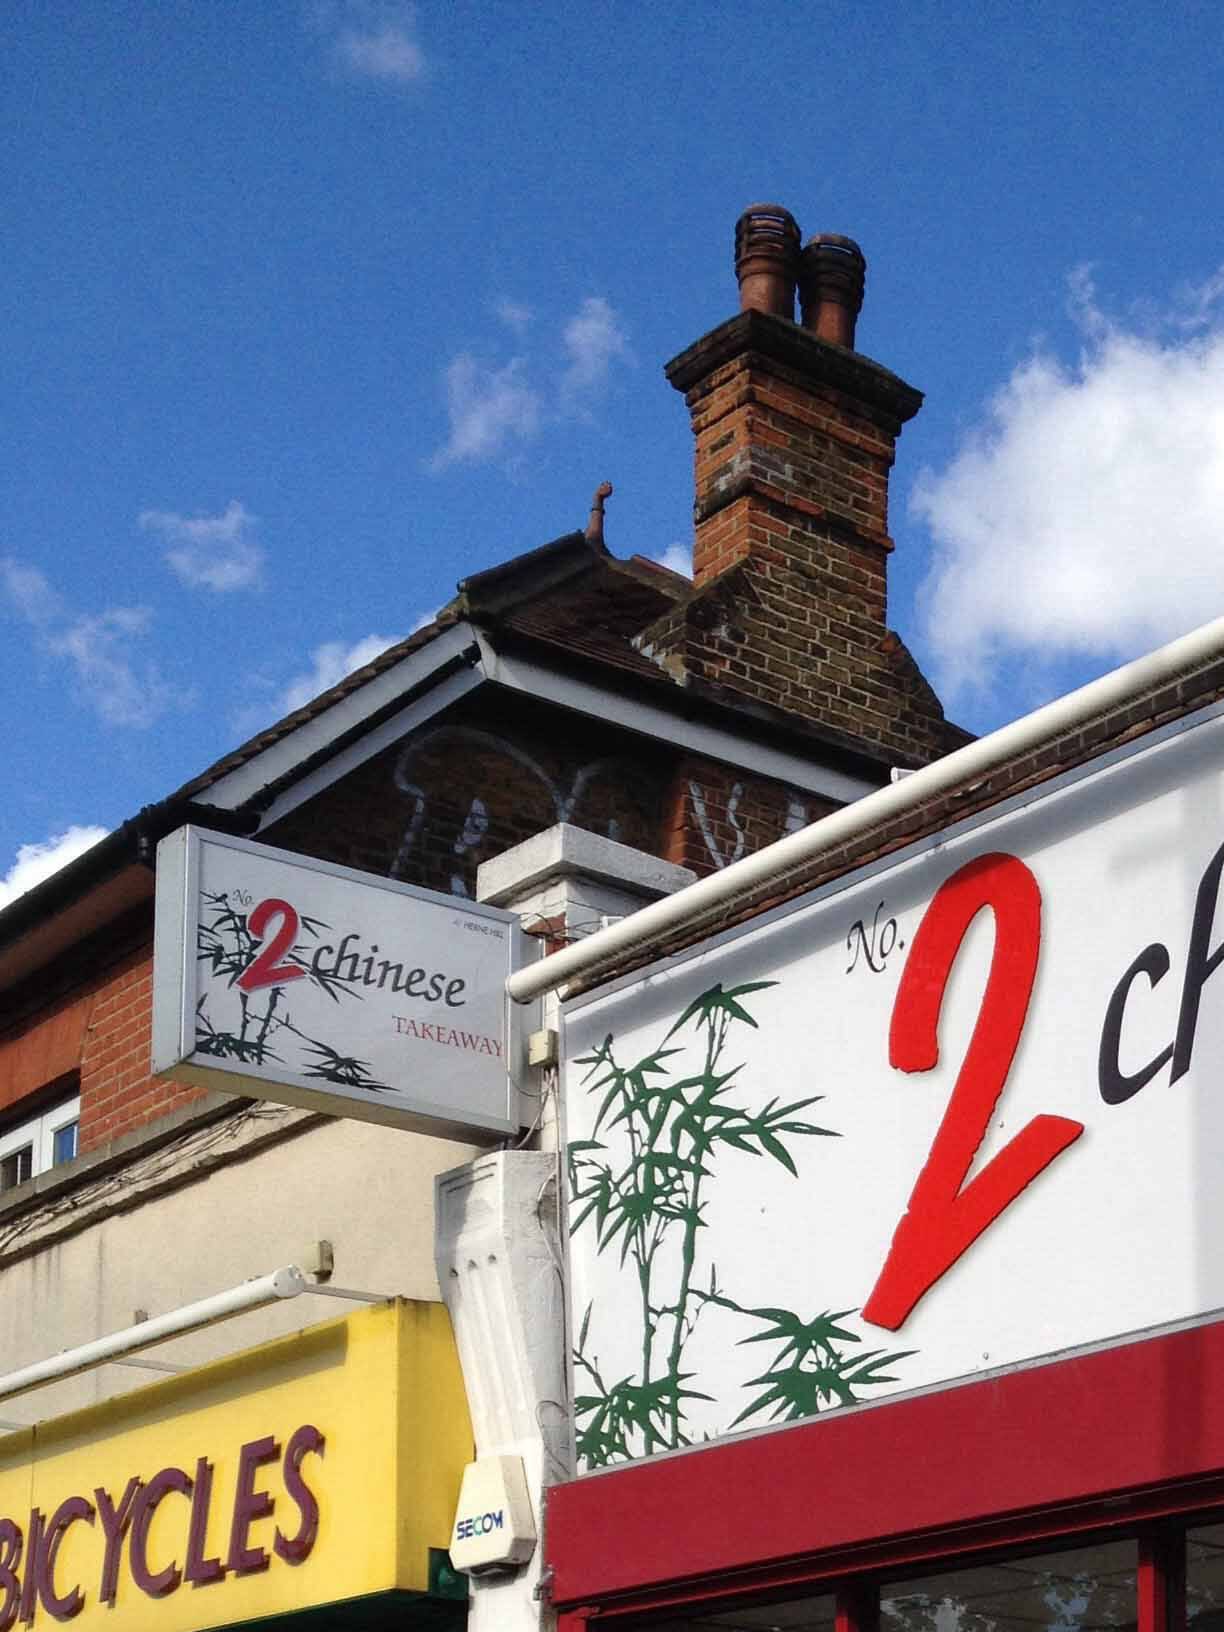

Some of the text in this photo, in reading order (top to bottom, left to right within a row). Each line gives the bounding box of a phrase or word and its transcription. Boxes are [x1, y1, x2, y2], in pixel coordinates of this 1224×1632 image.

[235, 897, 307, 993] 2
[312, 934, 466, 1007] chinese
[845, 900, 905, 975] No.
[391, 1013, 504, 1057] TAKEAWAY
[860, 851, 1084, 1331] 2
[456, 1509, 503, 1541] SECOM
